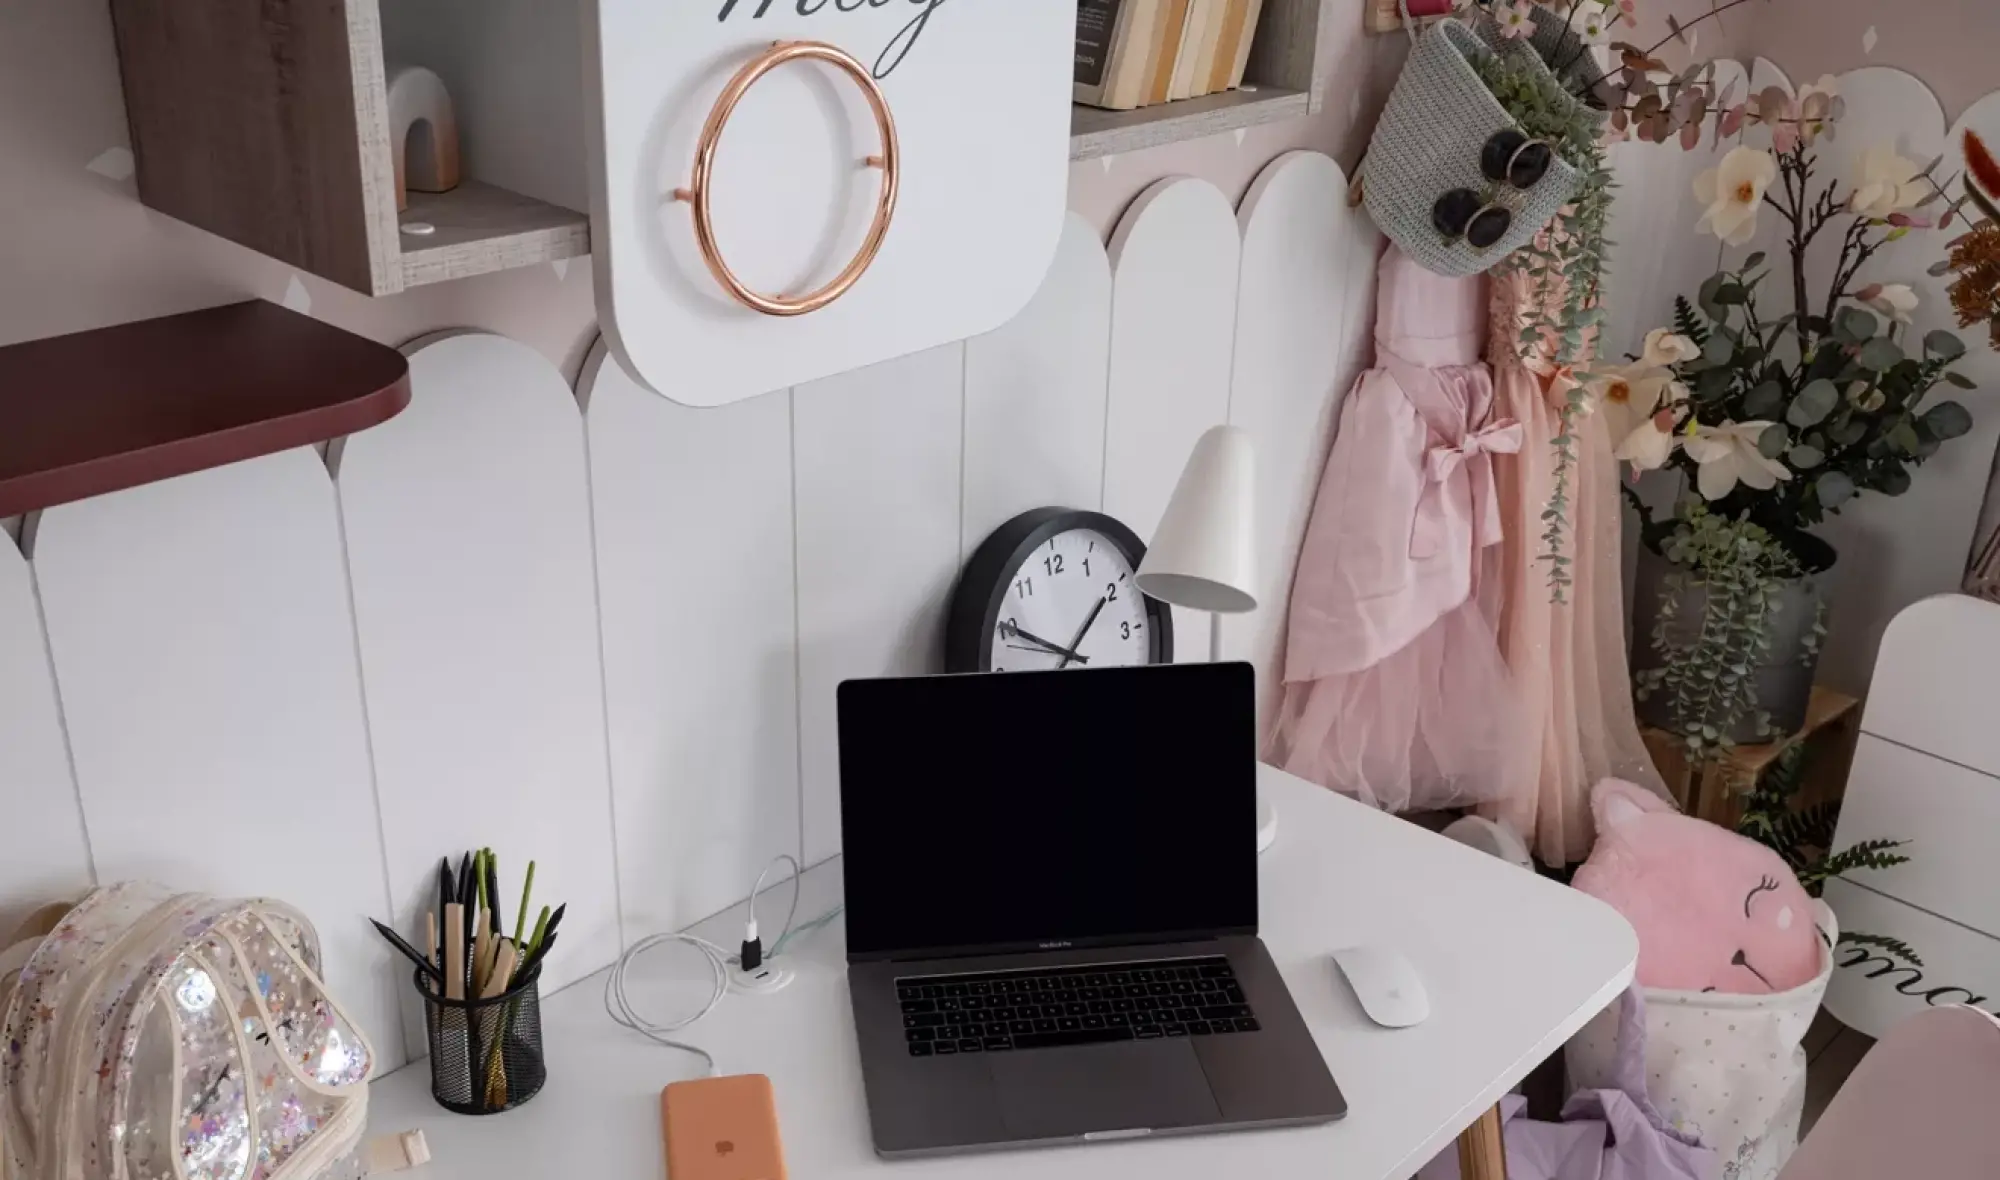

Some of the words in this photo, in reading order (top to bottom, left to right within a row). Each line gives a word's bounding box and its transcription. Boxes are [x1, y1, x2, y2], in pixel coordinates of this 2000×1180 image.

[1044, 554, 1064, 576] 12
[1082, 558, 1090, 577] 1
[1015, 577, 1032, 599] 11
[1107, 583, 1117, 602] 2
[1121, 621, 1130, 640] 3
